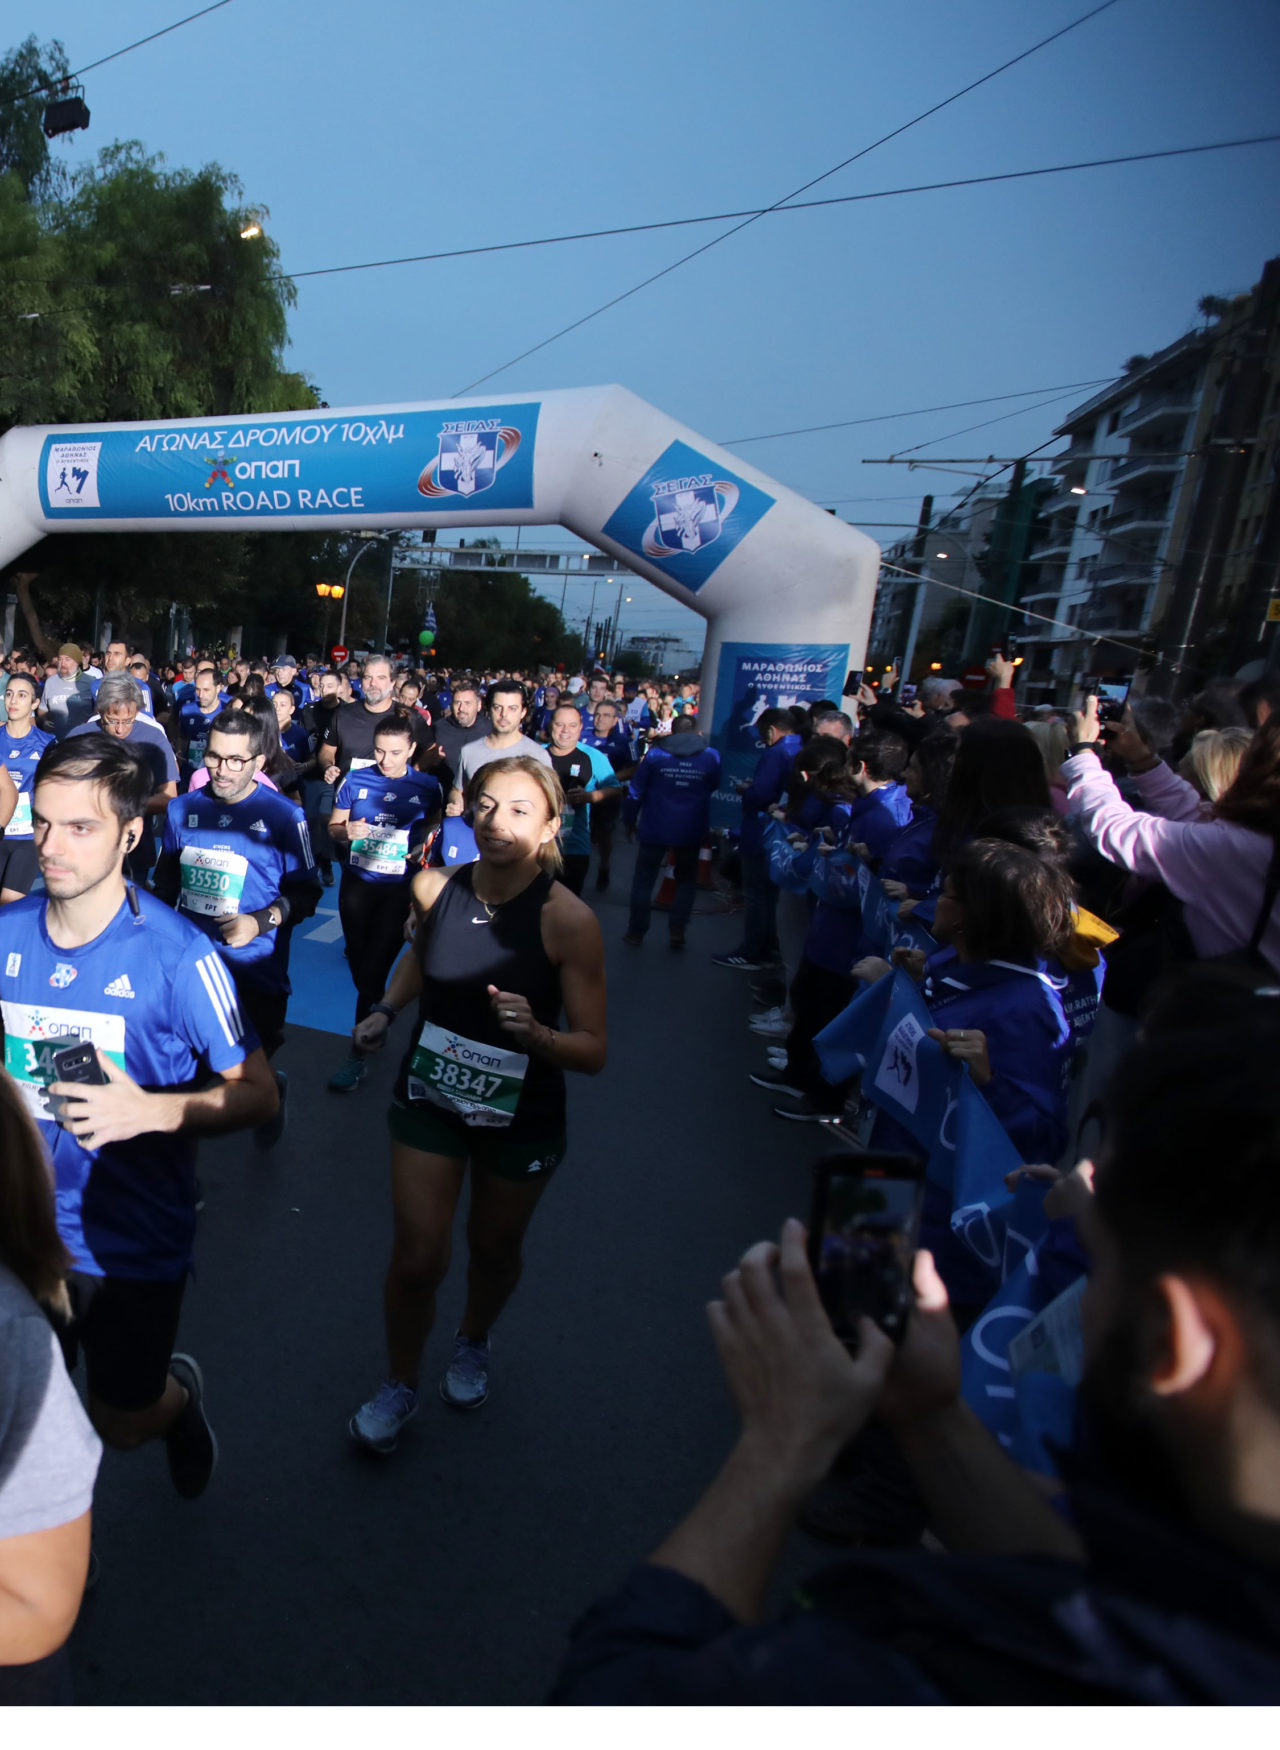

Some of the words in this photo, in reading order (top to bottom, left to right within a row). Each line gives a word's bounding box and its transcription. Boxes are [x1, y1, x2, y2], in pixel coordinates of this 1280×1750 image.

[442, 418, 501, 433] ΣΕΓΑΣ
[135, 431, 227, 453] ΑΓΩΝΑΣ
[228, 423, 337, 448] ΔΡΟΜΟΥ
[340, 420, 404, 446] 10χλμ
[235, 459, 300, 480] οπαπ
[650, 473, 713, 496] ΣΕΓΑΣ
[164, 491, 219, 512] 10km
[222, 489, 291, 510] ROAD
[298, 487, 365, 508] RACE
[741, 661, 823, 673] ΜΑΡΑΘΩΝΙΟΣ
[754, 672, 807, 683] ΑΘΗΝΑΣ
[362, 840, 398, 857] 35484
[188, 867, 230, 891] 35530
[104, 986, 135, 999] adidas
[461, 1049, 502, 1068] οπαπ
[429, 1057, 503, 1098] 38347
